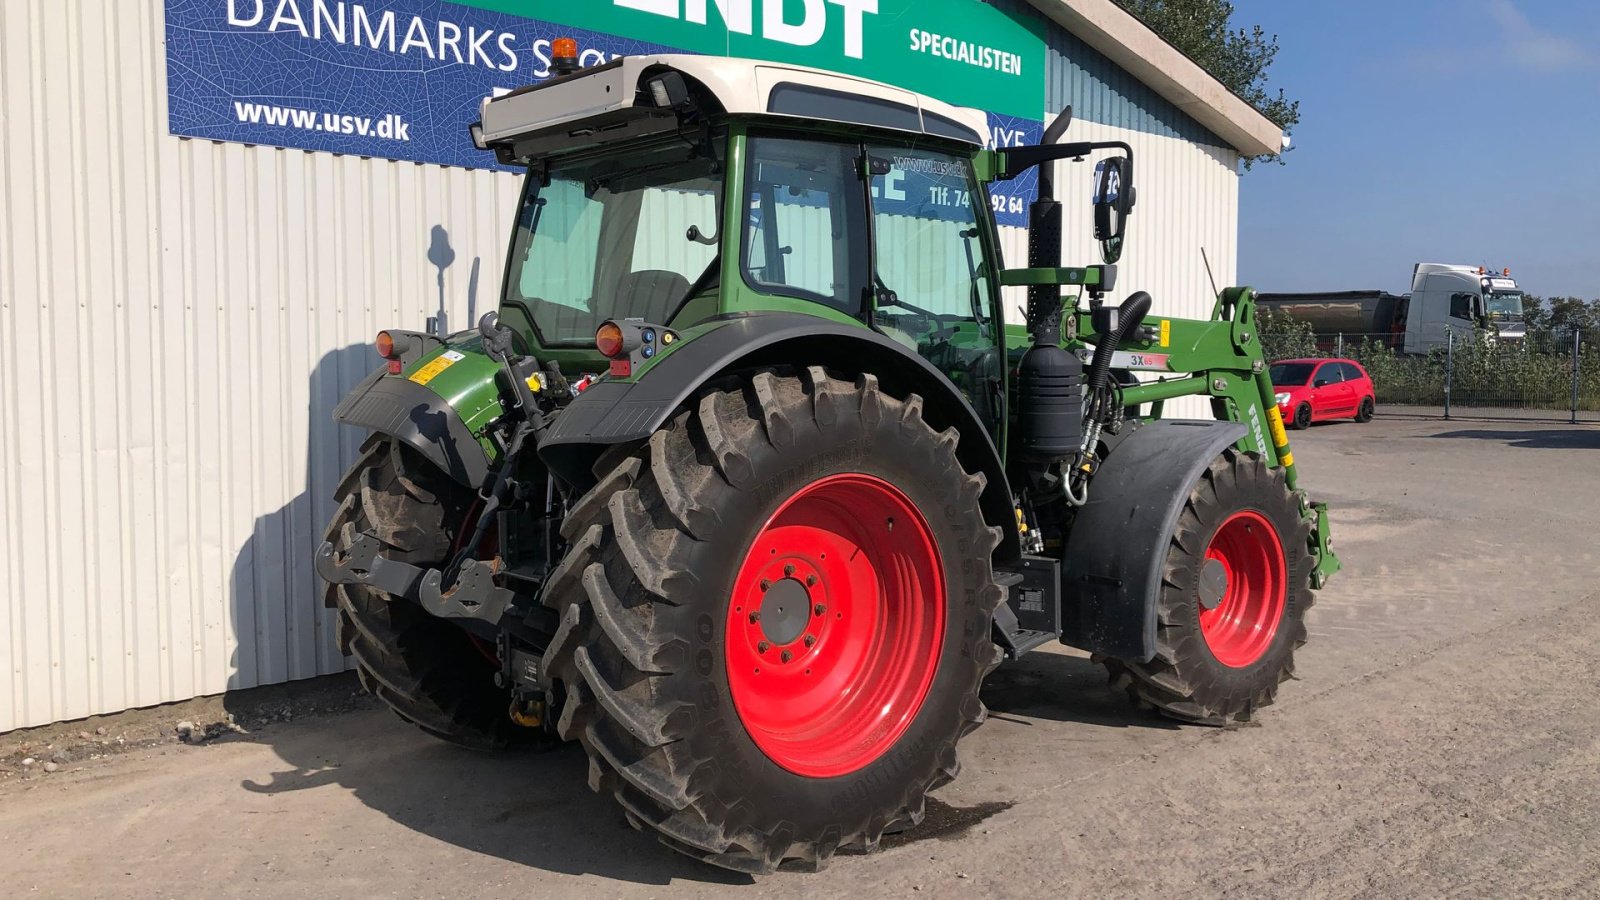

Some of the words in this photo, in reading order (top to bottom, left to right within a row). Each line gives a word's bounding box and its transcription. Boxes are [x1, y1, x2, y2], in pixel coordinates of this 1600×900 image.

[227, 0, 518, 72] DANMARKS
[909, 28, 1021, 76] SPECIALISTEN
[234, 101, 410, 141] www.usv.dk
[929, 187, 951, 206] Tlf.
[954, 189, 970, 208] 74
[991, 194, 1006, 212] 92
[1009, 196, 1023, 214] 64
